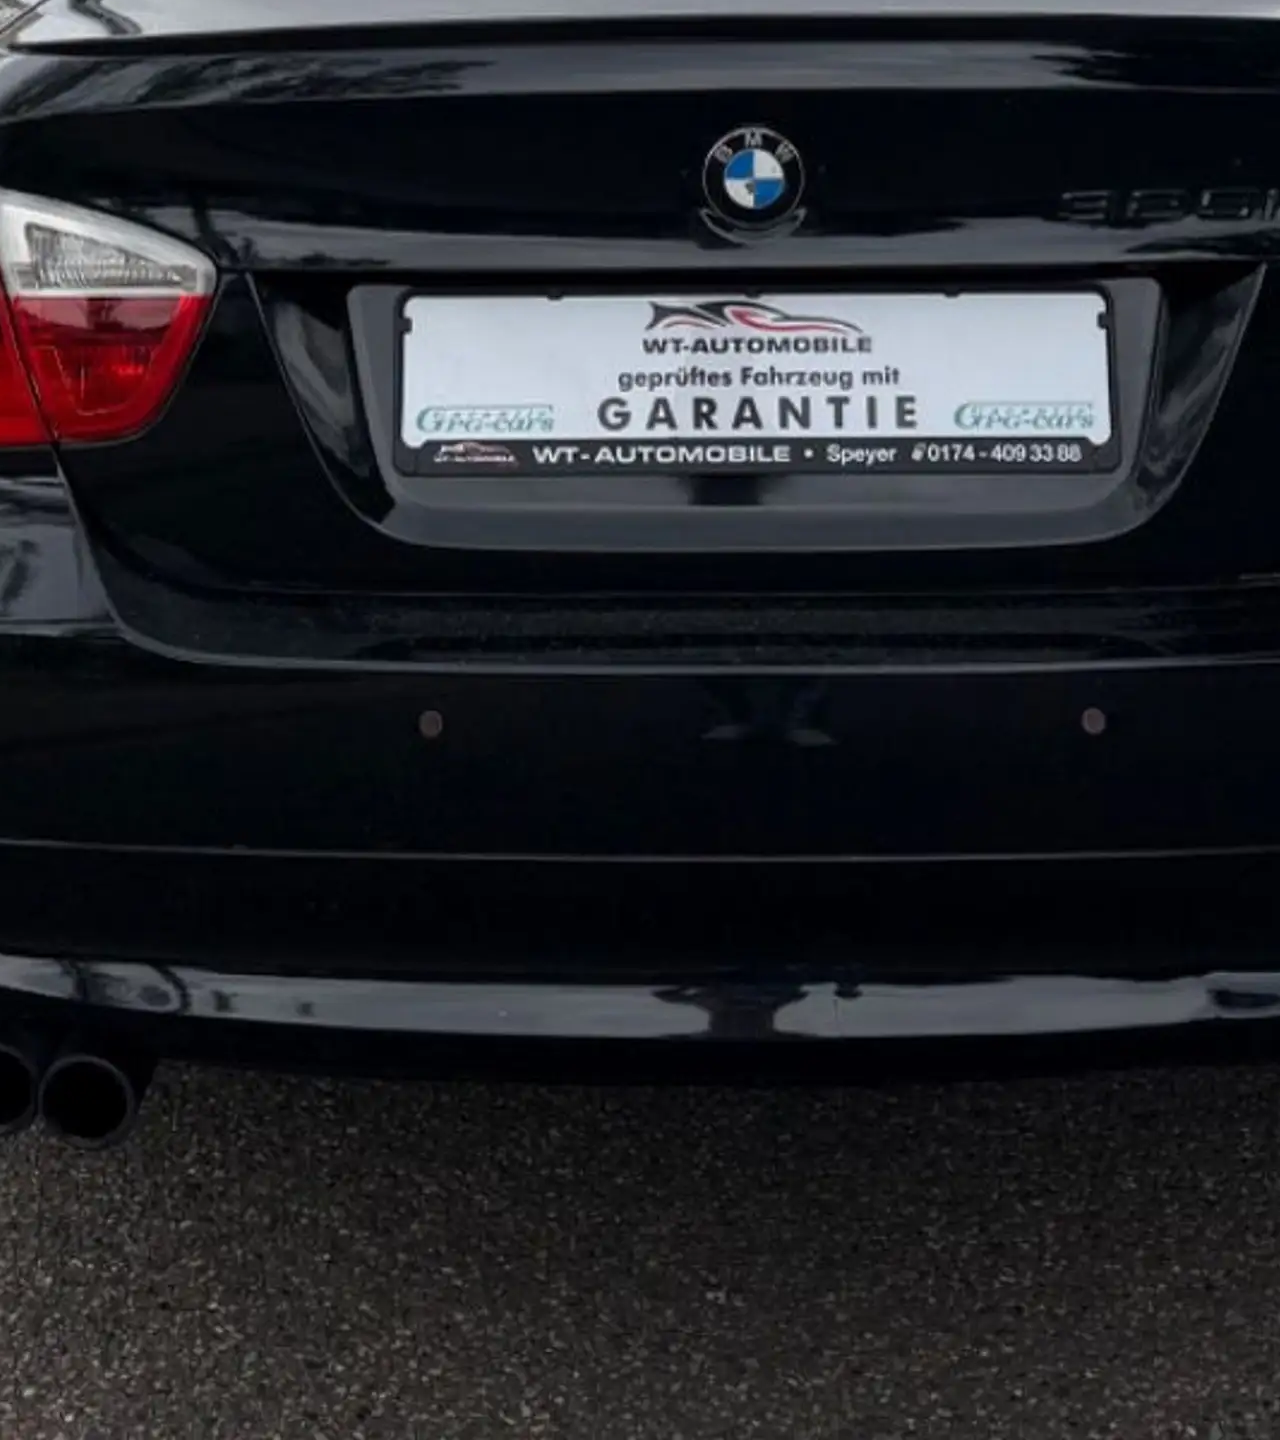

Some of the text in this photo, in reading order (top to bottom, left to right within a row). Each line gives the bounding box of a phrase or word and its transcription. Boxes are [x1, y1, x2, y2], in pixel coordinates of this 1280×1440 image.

[642, 336, 873, 354] WT-AUTOMOBILE
[618, 366, 900, 392] geprüftes Fahrzeug mit
[597, 396, 918, 431] GARANTIE
[826, 443, 897, 467] Speyer
